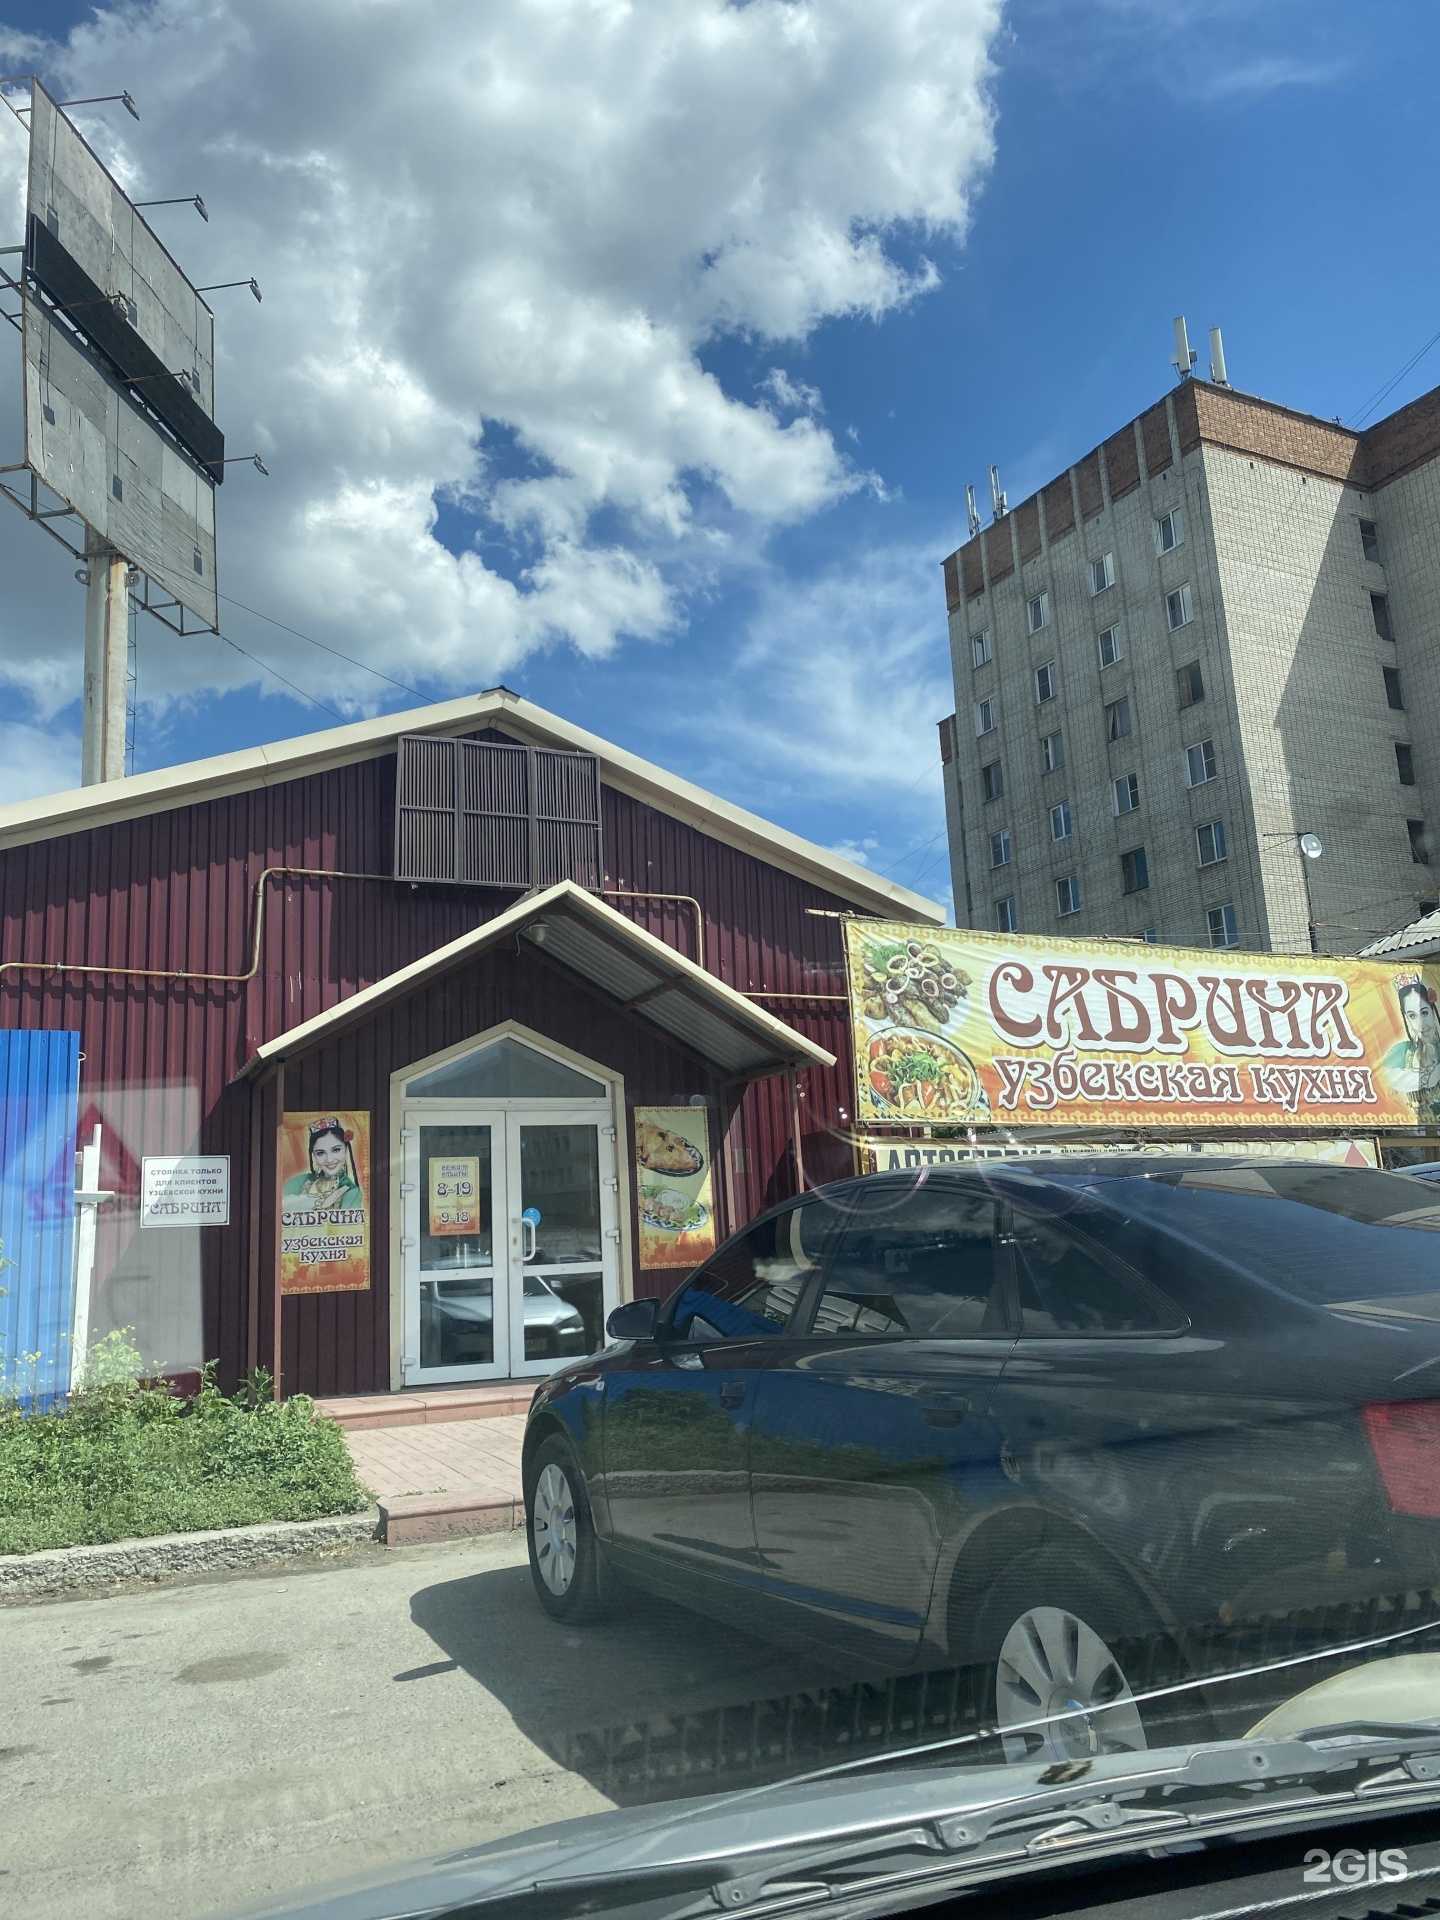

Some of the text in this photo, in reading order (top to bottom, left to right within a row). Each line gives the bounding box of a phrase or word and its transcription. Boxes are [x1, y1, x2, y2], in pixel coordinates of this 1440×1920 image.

[989, 962, 1358, 1050] САБРИНА
[998, 1050, 1377, 1110] узбекская кухня
[437, 1181, 472, 1196] 8-19
[281, 1209, 365, 1227] САБРИНА
[283, 1234, 363, 1251] узбекская
[300, 1249, 346, 1263] кухня
